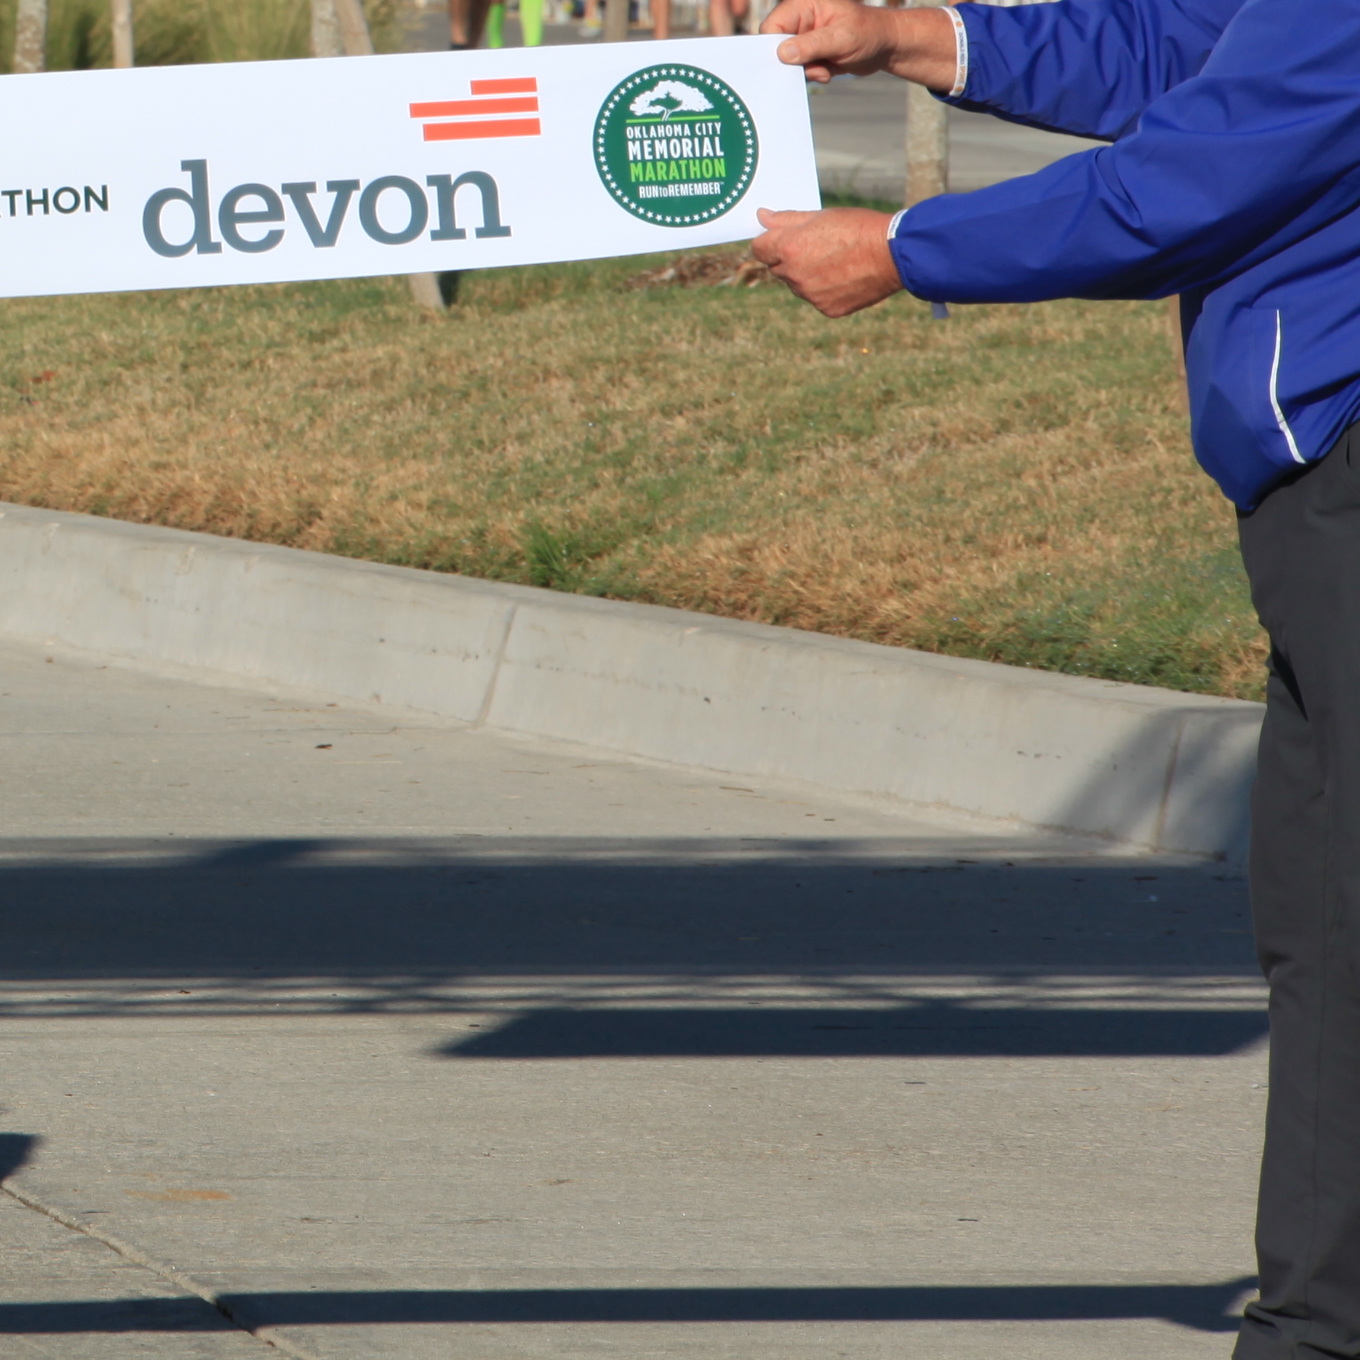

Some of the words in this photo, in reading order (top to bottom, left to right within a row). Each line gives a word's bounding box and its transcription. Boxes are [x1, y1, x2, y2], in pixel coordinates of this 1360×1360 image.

[626, 123, 691, 139] OKLAHOMA
[695, 122, 722, 136] CITY
[627, 136, 724, 161] MEMORIAL
[629, 158, 726, 182] MARATHON
[141, 158, 512, 259] devon
